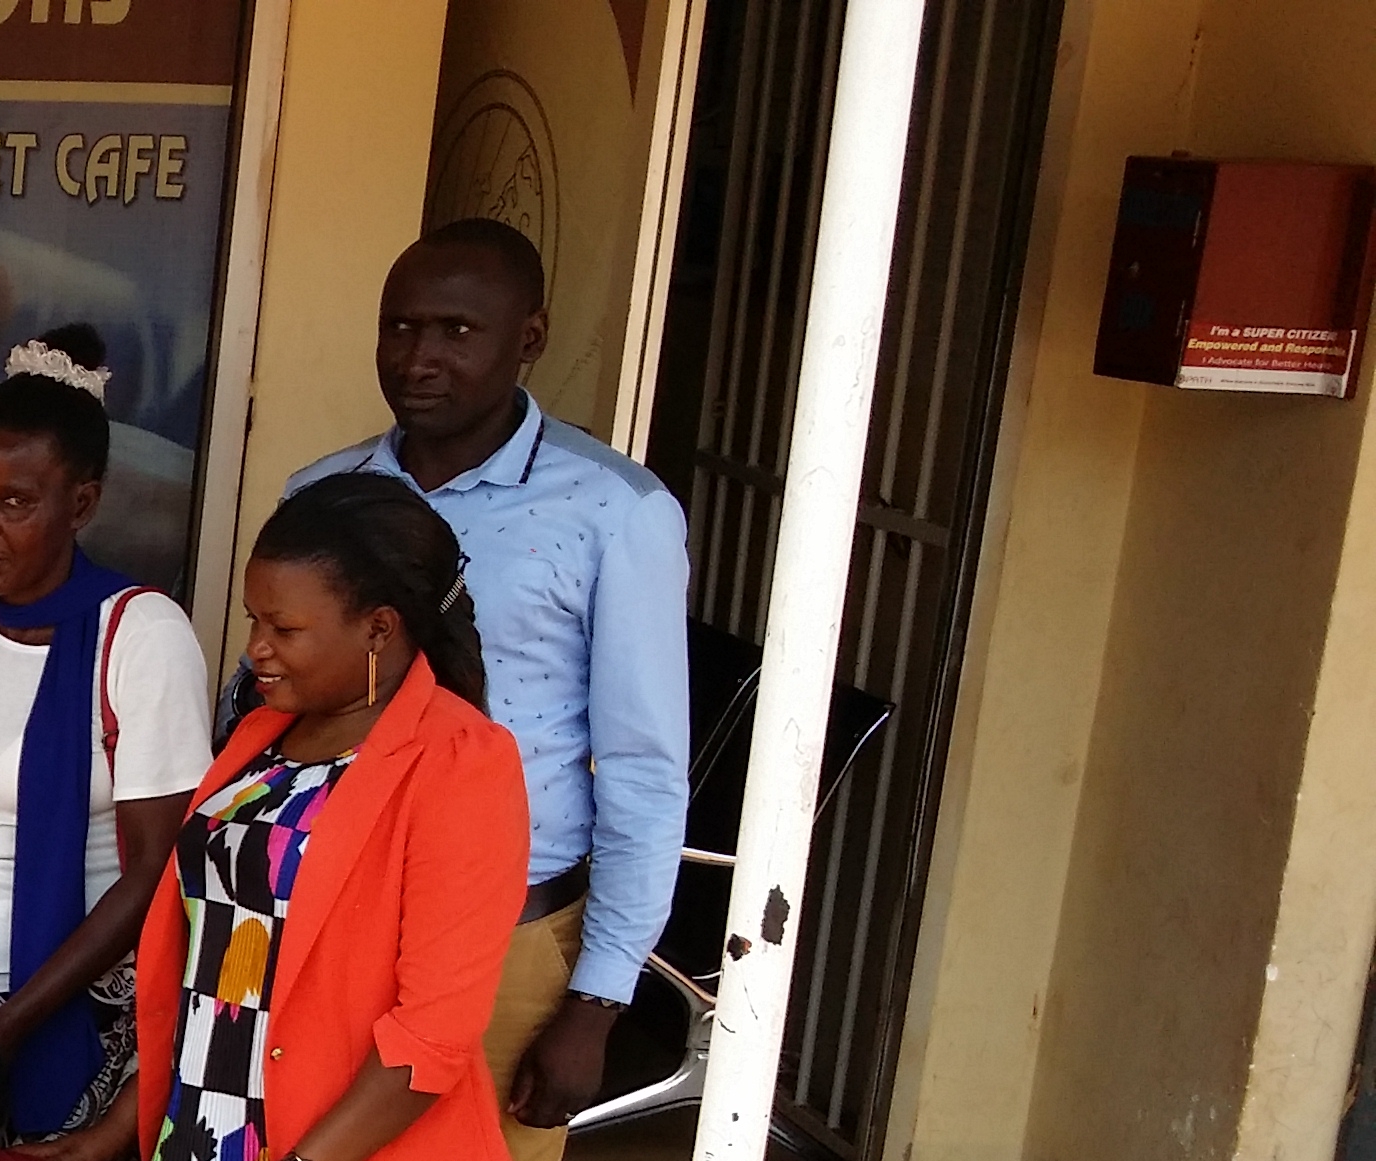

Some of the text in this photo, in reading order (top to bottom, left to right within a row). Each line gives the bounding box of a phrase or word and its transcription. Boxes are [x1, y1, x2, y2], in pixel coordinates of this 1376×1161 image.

[56, 134, 186, 203] CAFE
[1231, 328, 1240, 337] a
[1243, 327, 1285, 339] SUPER
[1187, 338, 1257, 352] Empowered
[1260, 343, 1282, 353] and
[1207, 356, 1253, 367] Advocate
[1255, 358, 1269, 368] for
[1271, 360, 1301, 370] Better
